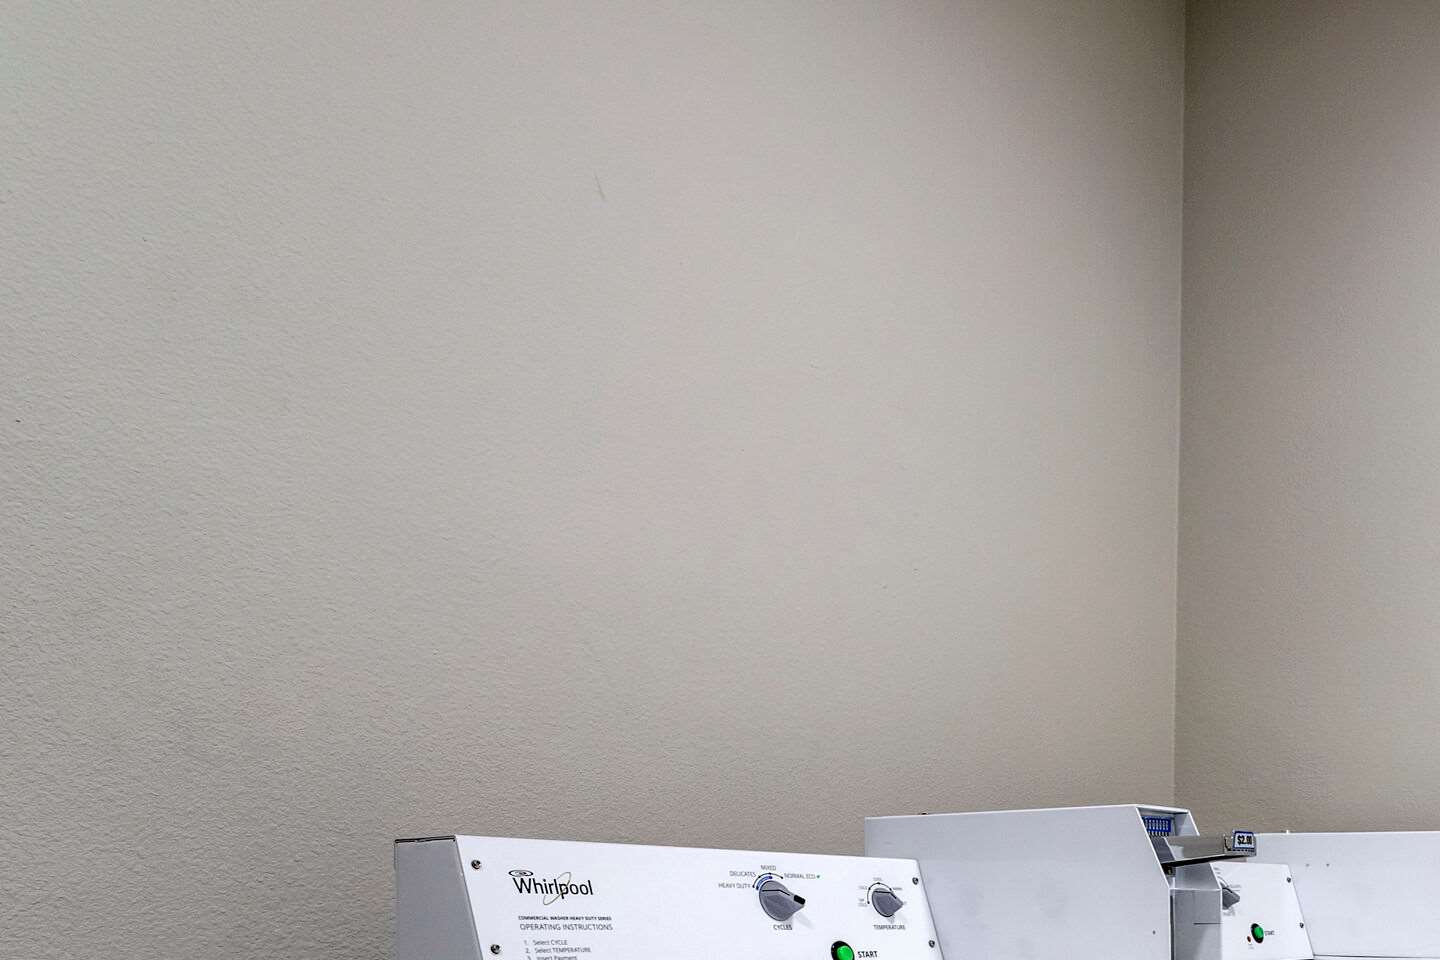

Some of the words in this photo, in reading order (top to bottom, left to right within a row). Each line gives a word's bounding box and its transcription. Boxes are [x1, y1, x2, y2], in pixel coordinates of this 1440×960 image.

[729, 870, 757, 878] DELICATES
[512, 877, 593, 900] Whirlpool
[519, 923, 561, 931] OPERATING
[562, 923, 614, 931] INSTRUCTIONS
[857, 950, 878, 959] START
